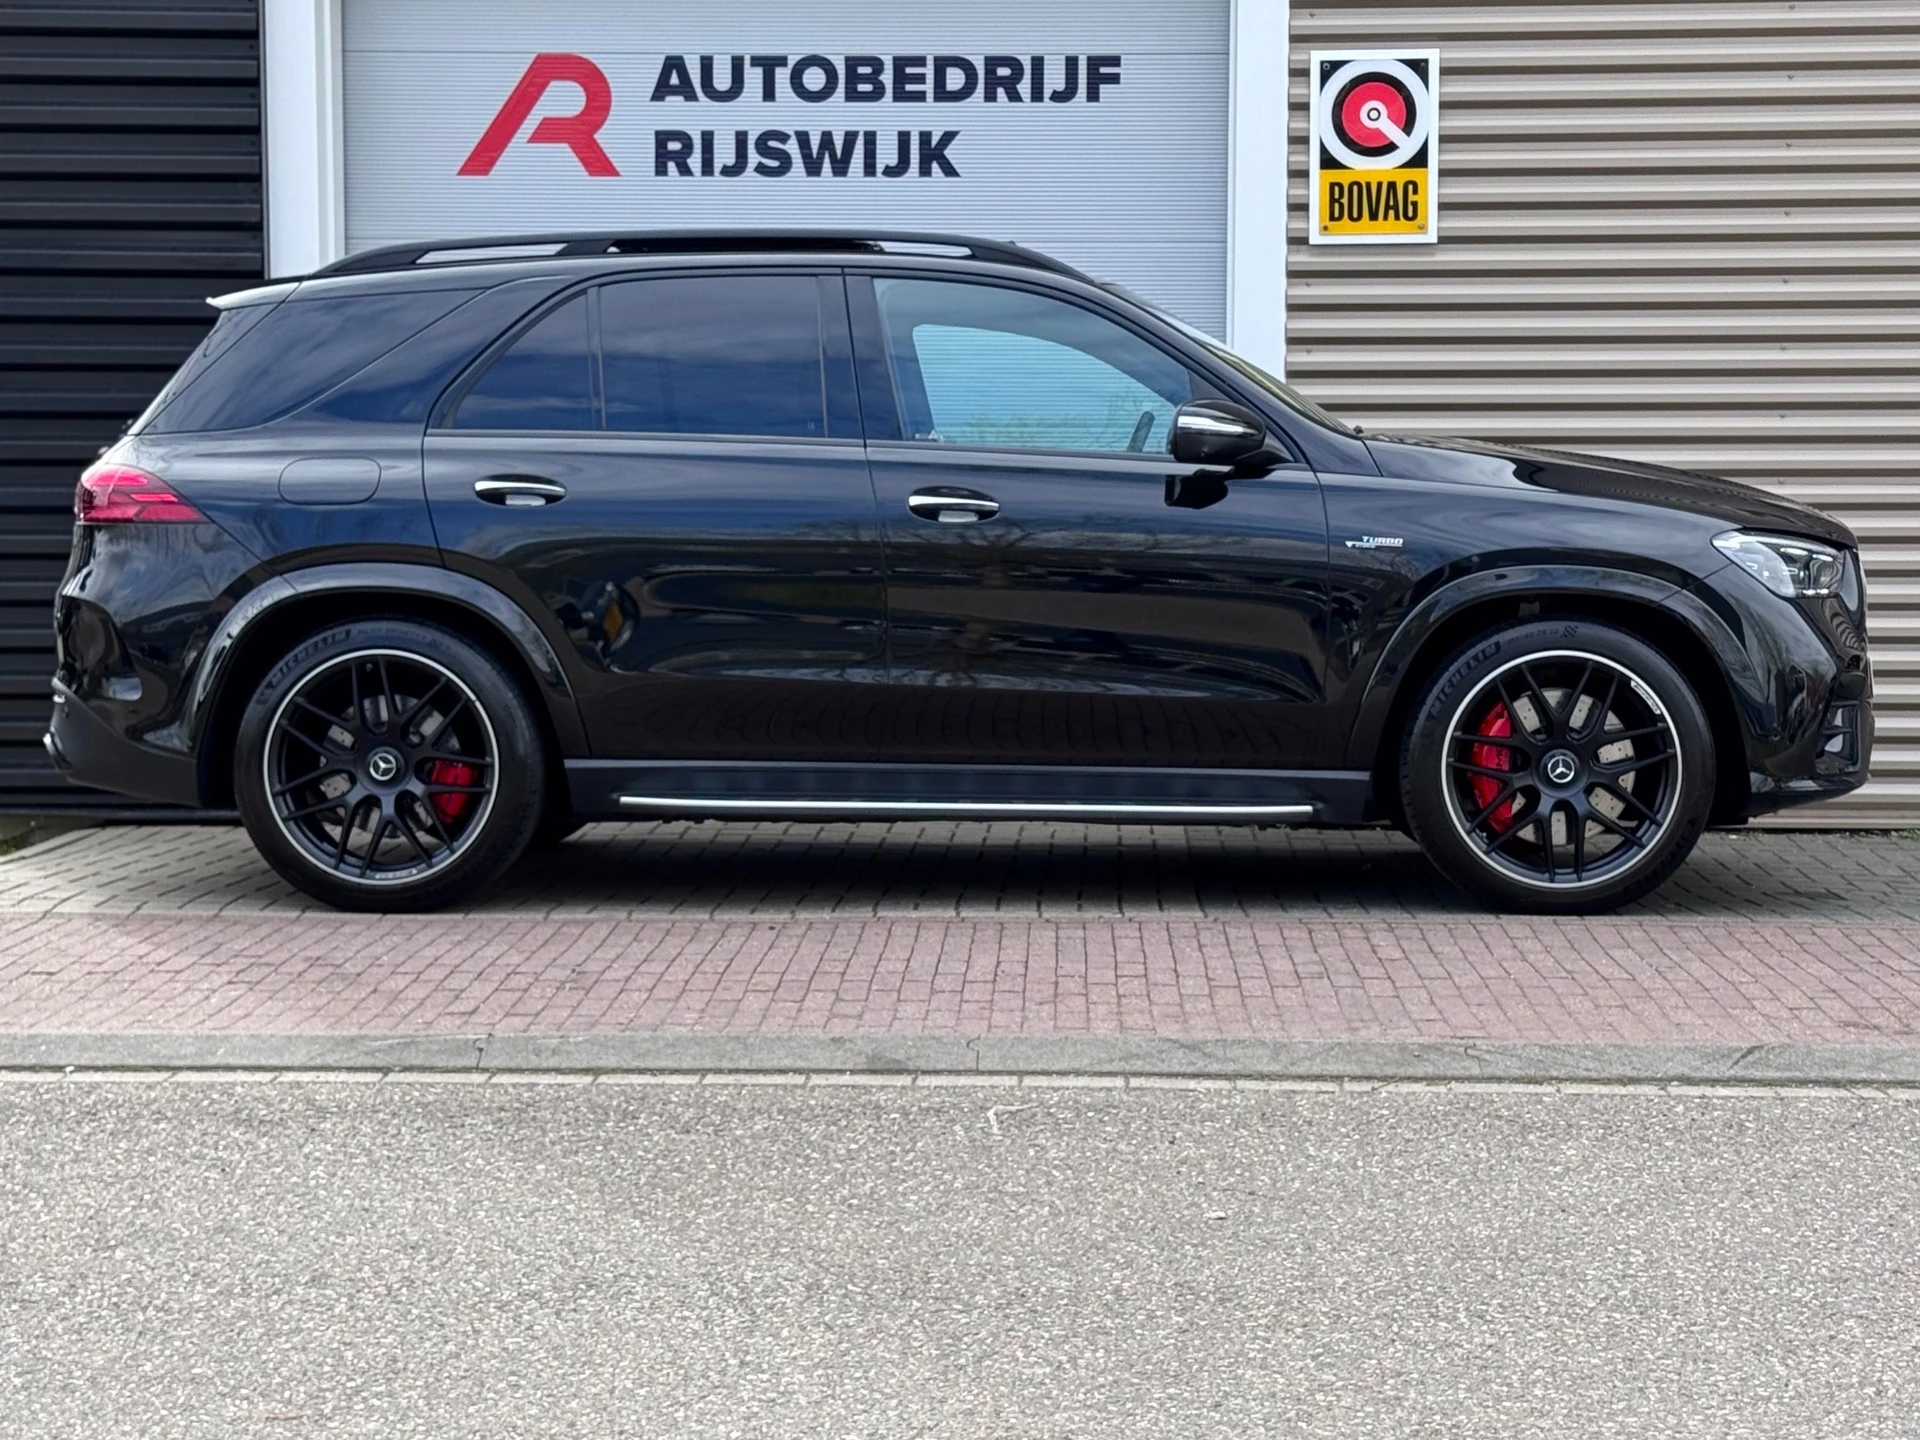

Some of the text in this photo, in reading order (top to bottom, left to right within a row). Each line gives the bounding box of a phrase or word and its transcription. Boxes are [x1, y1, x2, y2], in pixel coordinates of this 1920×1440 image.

[650, 54, 1121, 103] AUTOBEDRIJF
[654, 129, 961, 177] RIJSWIJK
[1328, 180, 1419, 222] BOVAG
[1362, 536, 1404, 545] TURBO
[1430, 642, 1497, 717] MICHELIN
